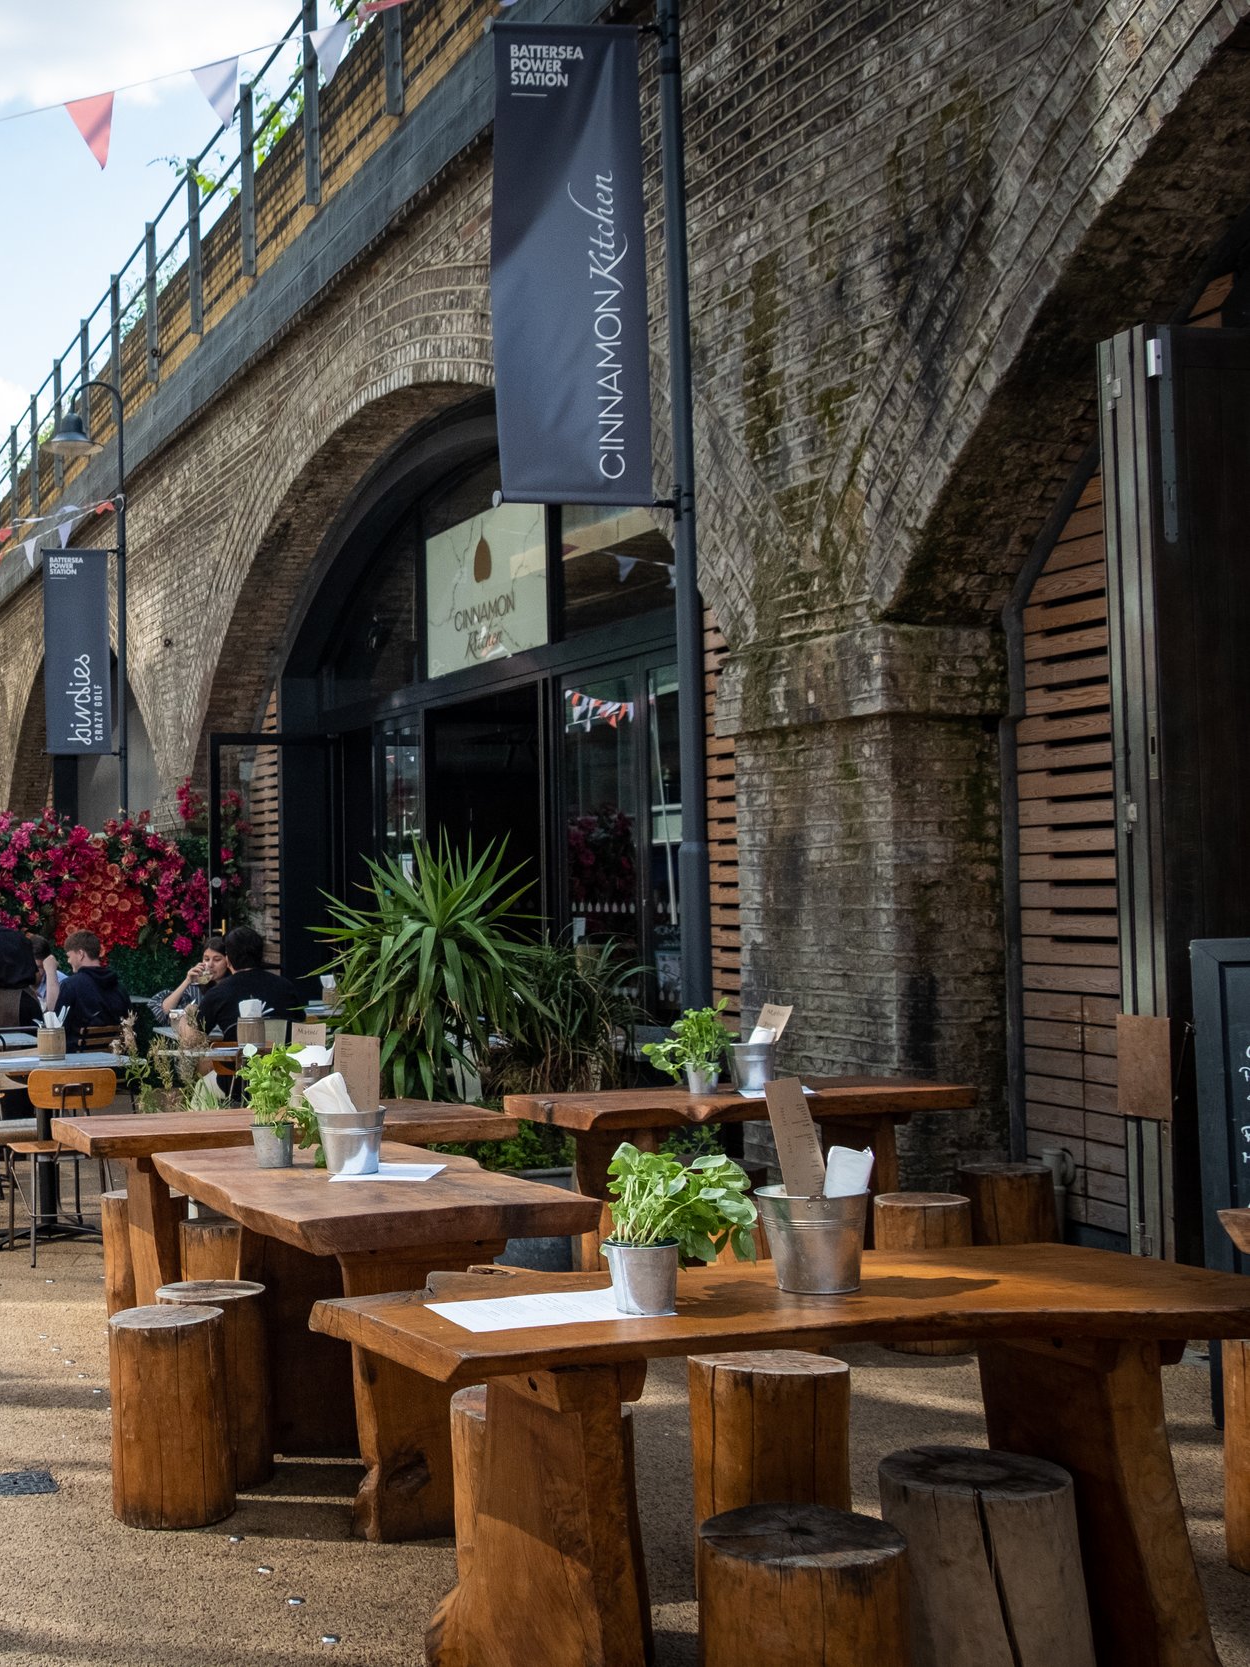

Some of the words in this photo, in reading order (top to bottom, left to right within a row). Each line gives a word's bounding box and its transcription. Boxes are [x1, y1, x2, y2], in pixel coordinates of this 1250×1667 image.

[510, 44, 584, 60] BATTERSEA
[510, 58, 562, 73] POWER
[510, 72, 569, 87] STATION
[567, 169, 628, 290] Kitchen
[594, 290, 626, 480] CINNAMON
[454, 592, 515, 632] CINNAMON
[66, 653, 92, 746] birdies
[94, 684, 103, 706] GOLF
[94, 712, 103, 741] CRAZY
